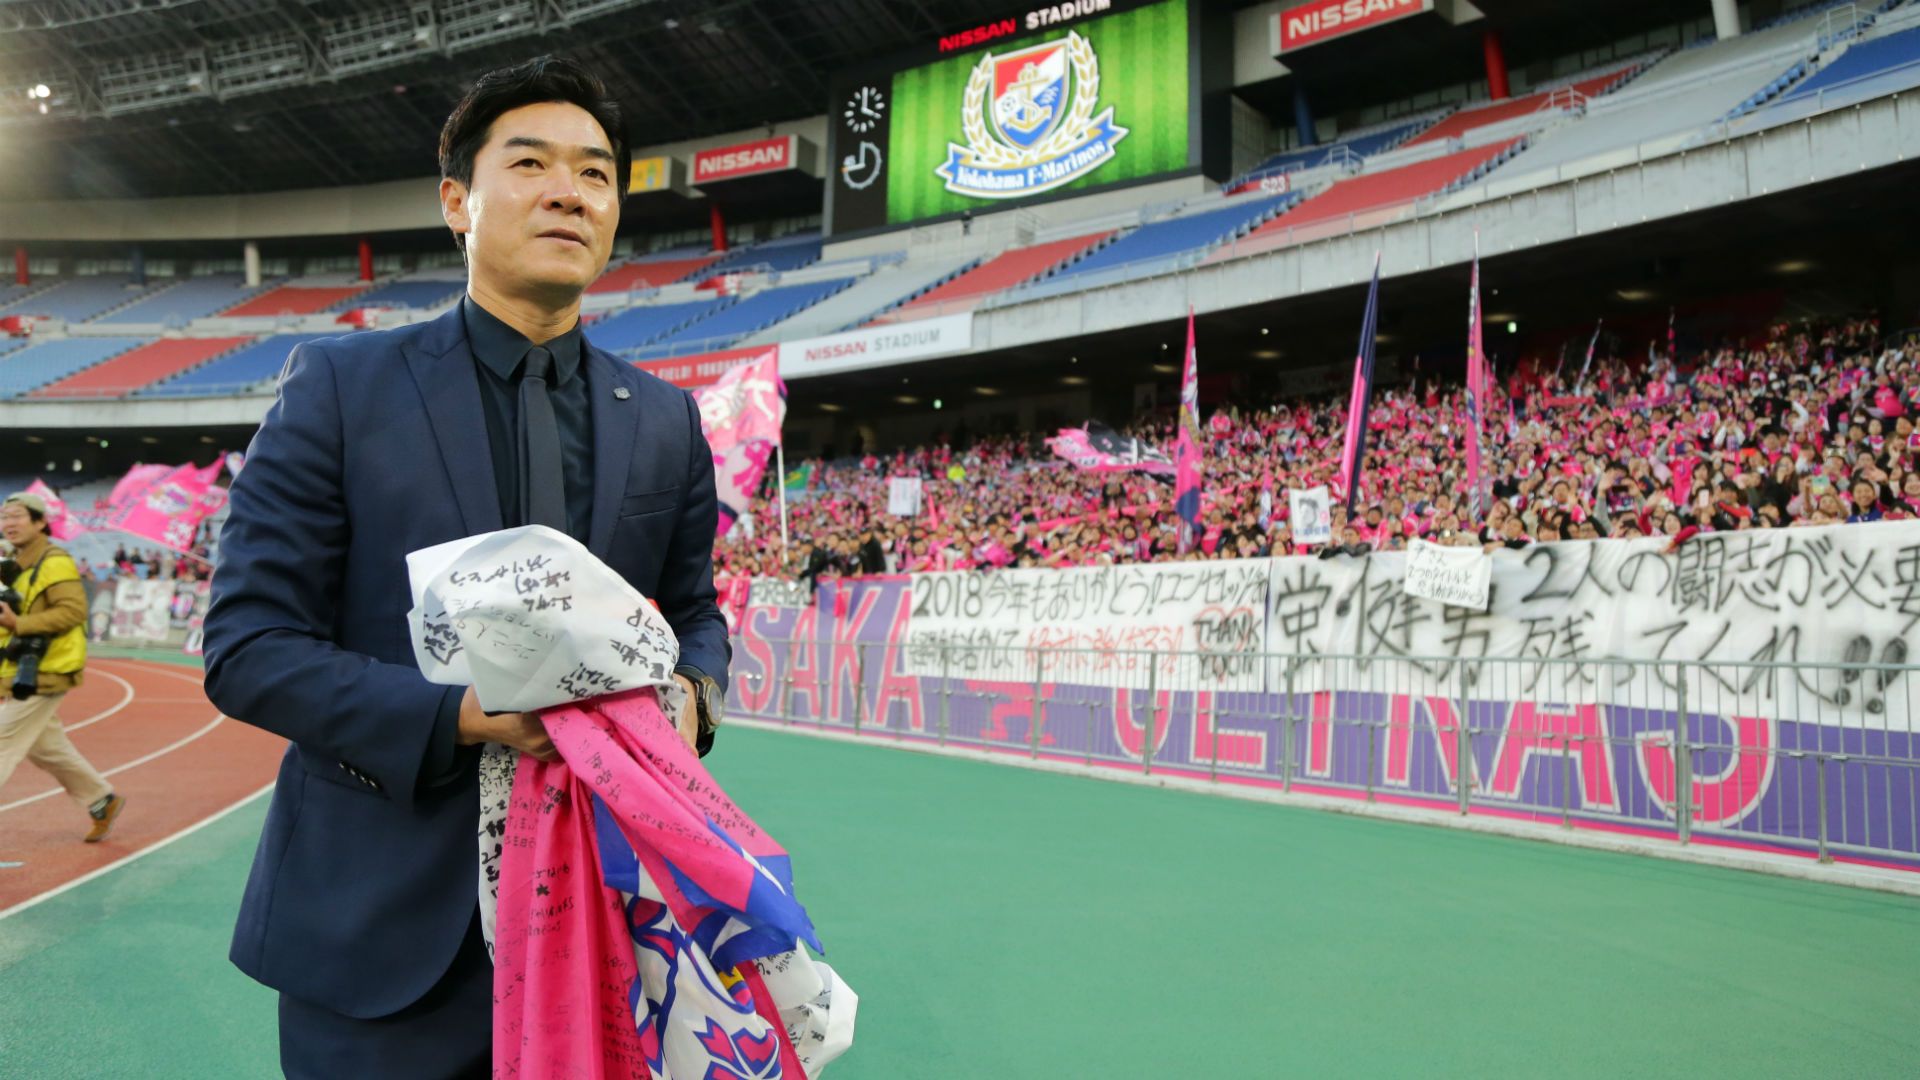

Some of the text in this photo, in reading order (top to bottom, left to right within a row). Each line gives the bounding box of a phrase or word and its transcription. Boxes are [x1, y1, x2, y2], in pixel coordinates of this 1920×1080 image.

[938, 0, 1111, 53] NISSAN STADIUM
[700, 143, 784, 176] NISSAN
[956, 165, 1025, 188] Yokohama
[805, 328, 941, 362] NISSAN STADIUM
[1192, 613, 1263, 644] THANK
